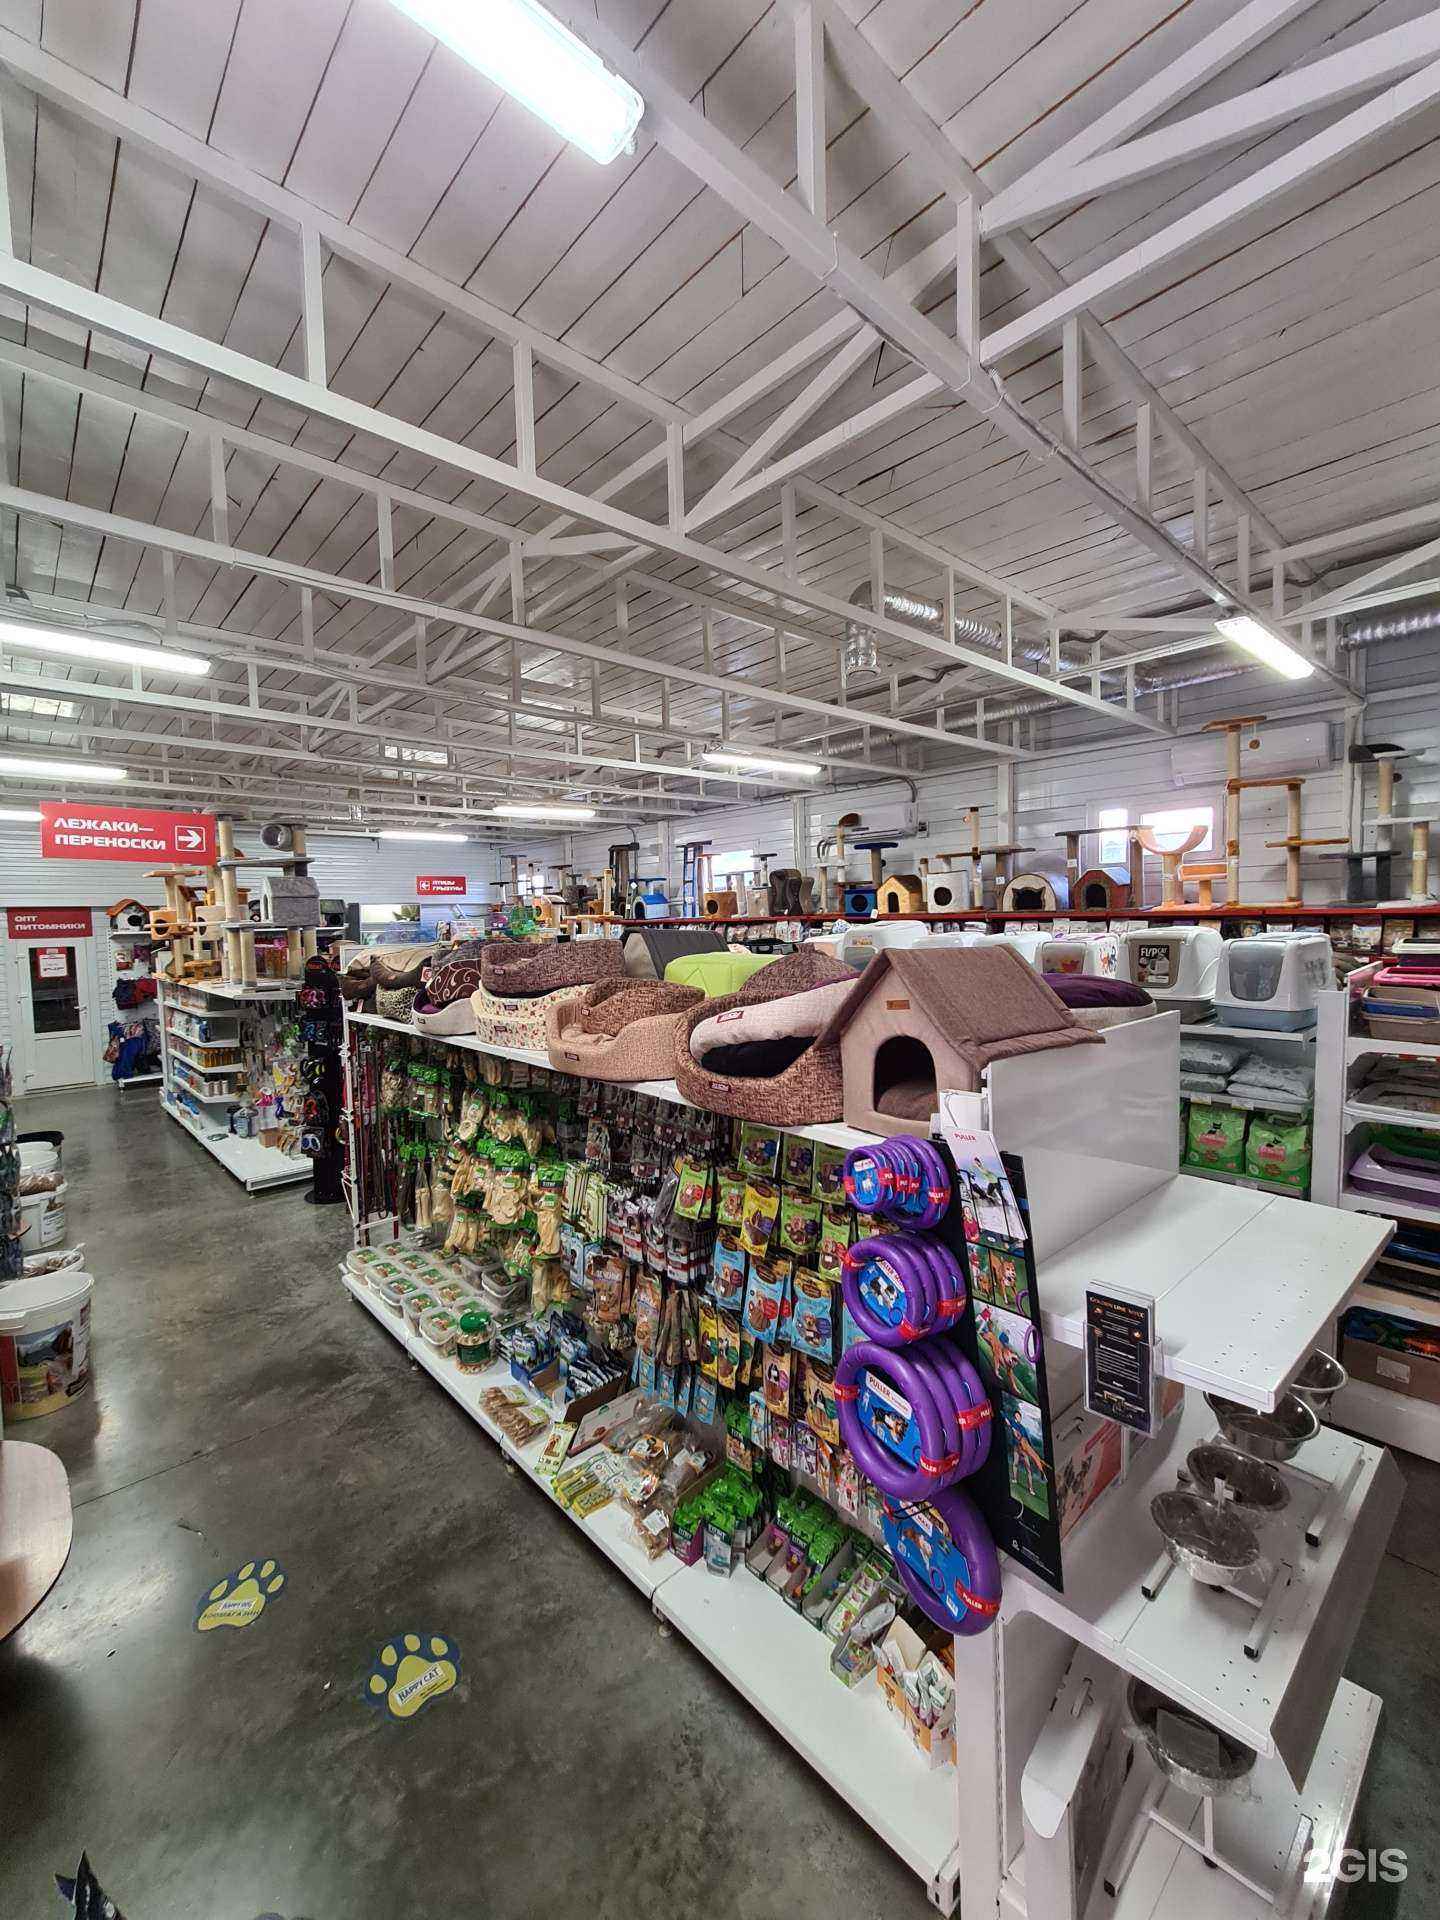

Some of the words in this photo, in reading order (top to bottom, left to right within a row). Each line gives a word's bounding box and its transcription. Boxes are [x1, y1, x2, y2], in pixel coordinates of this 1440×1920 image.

[54, 834, 166, 850] ПЕРЕНОСКИ
[14, 915, 38, 923] ОПТ
[14, 923, 86, 931] ПИТОМНИКИ
[869, 1376, 892, 1398] PULLER
[398, 1680, 423, 1702] HAPPY
[423, 1667, 439, 1682] CAT
